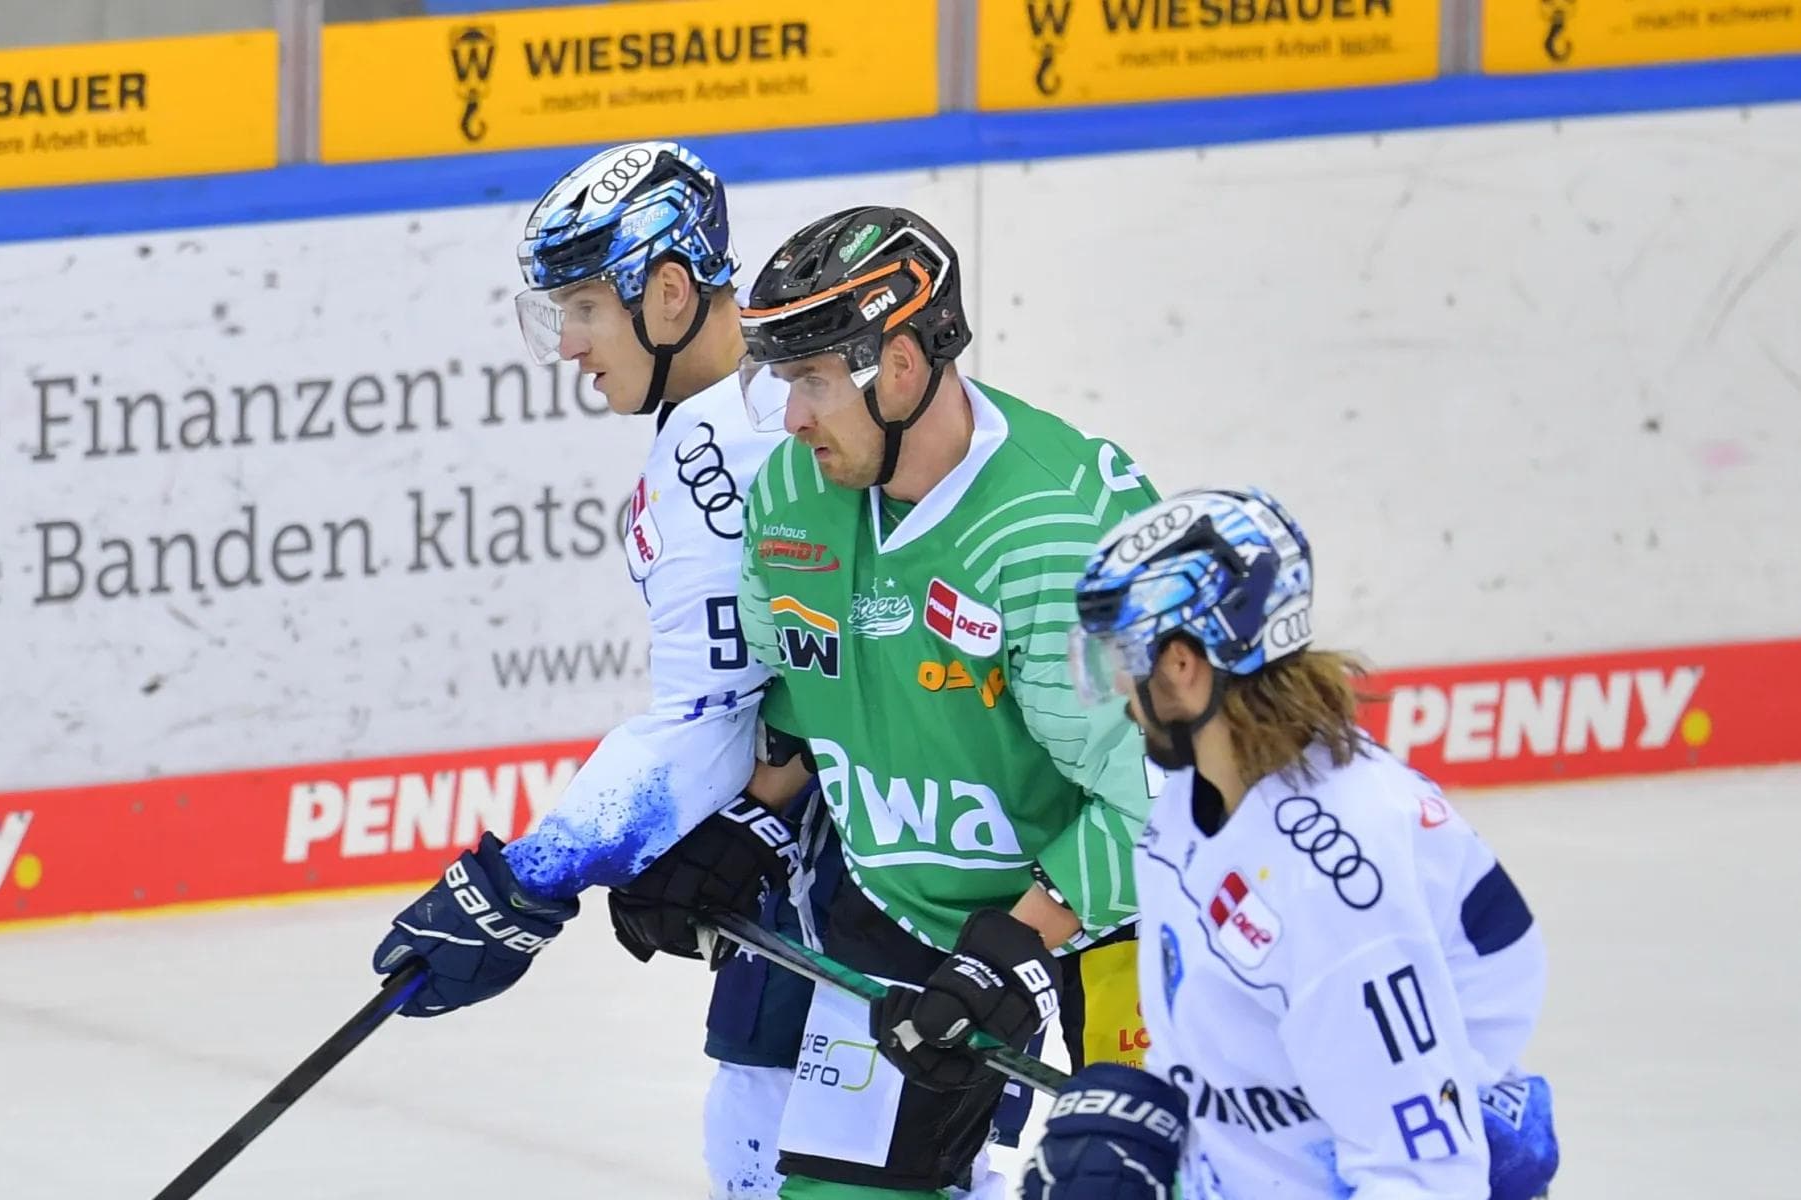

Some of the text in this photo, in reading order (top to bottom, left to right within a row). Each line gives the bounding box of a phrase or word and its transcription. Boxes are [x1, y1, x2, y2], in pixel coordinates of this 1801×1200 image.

[523, 21, 810, 80] WIESBAUER
[860, 290, 898, 322] BW
[31, 367, 452, 465] Finanzen
[33, 504, 378, 604] Banden
[956, 612, 999, 641] DEL
[952, 953, 1004, 988] NEXUS
[1363, 963, 1437, 1065] 10
